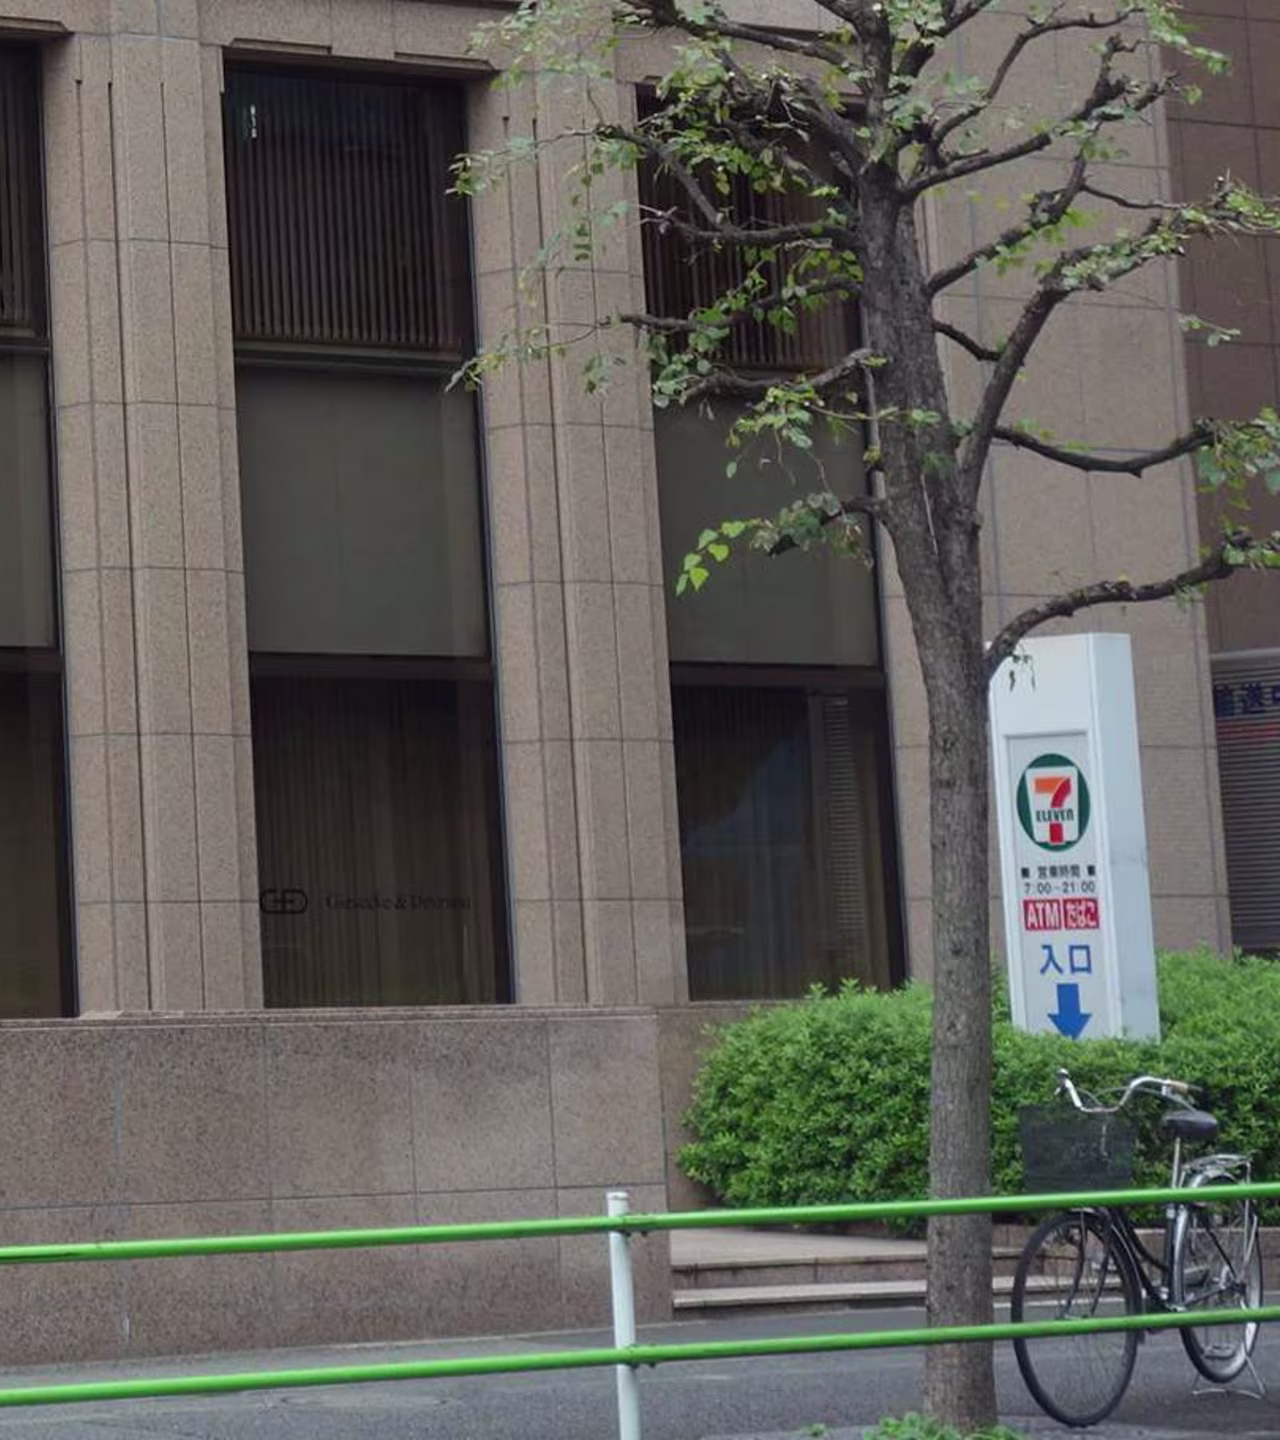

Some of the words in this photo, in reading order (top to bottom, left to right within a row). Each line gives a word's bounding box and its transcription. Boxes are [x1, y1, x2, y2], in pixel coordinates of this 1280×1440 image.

[1035, 776, 1072, 843] 7
[1027, 902, 1061, 928] ATM
[1040, 945, 1091, 974] 入口
